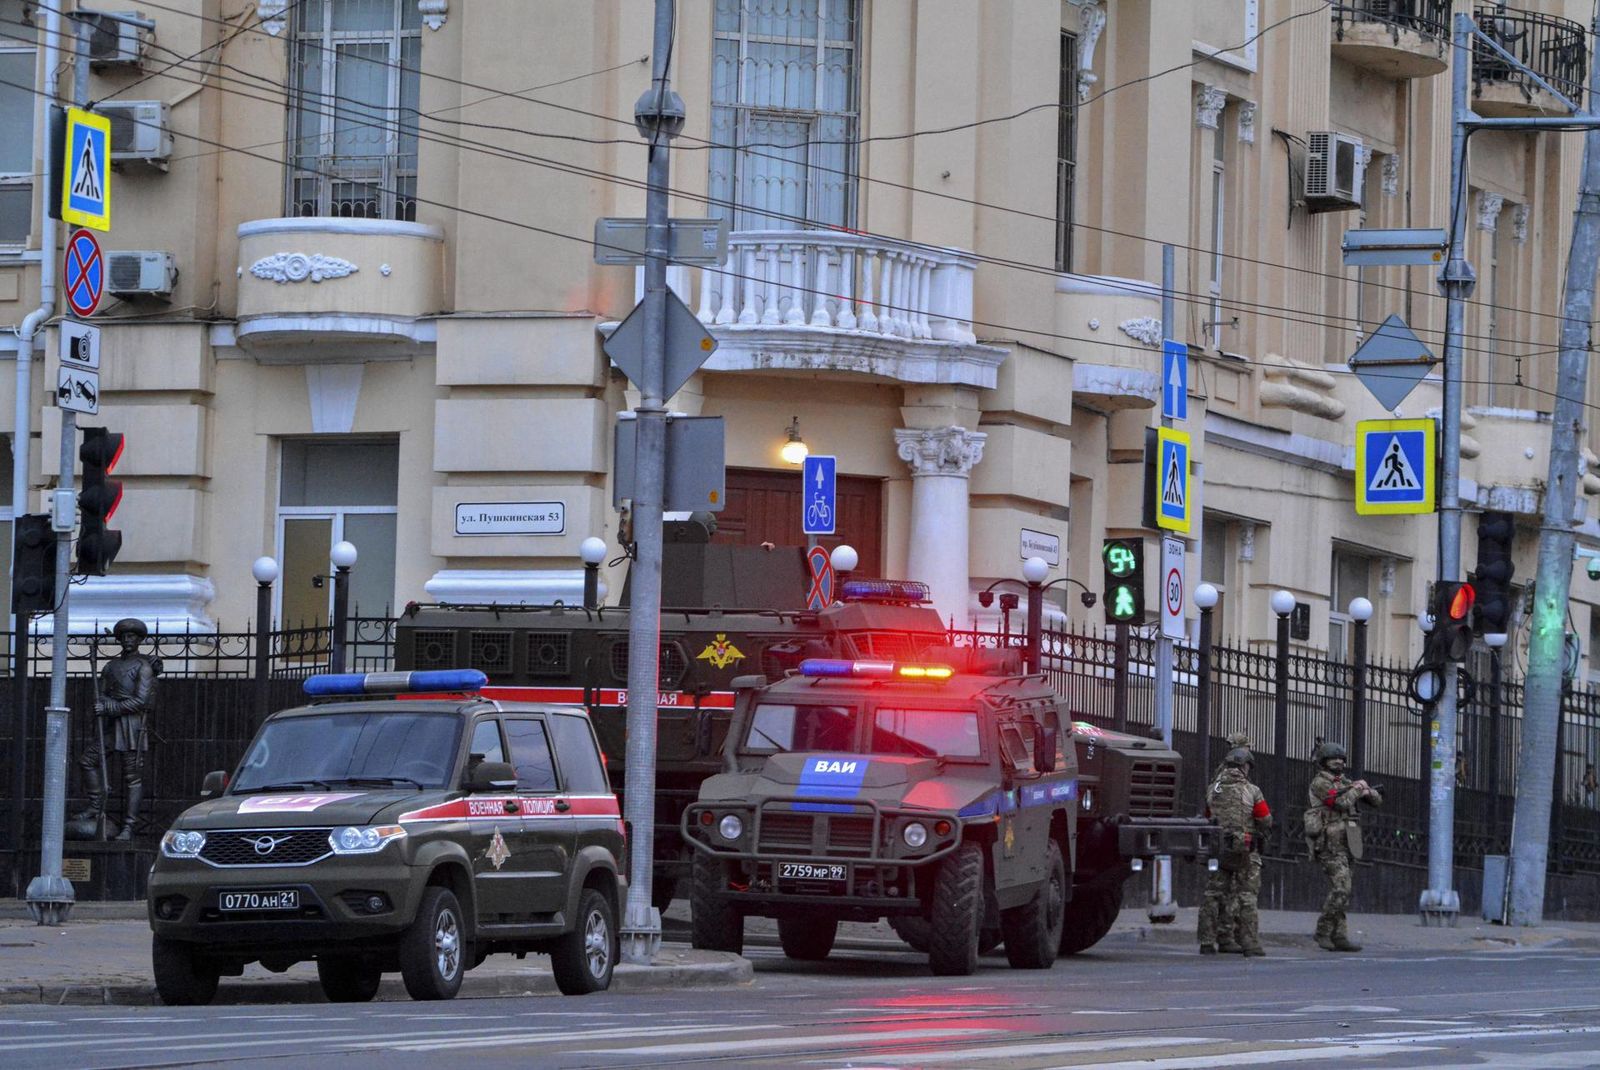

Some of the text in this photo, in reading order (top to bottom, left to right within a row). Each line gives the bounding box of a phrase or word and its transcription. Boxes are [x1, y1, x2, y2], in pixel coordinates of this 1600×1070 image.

[461, 512, 560, 525] ул. Пушкинская 53
[1168, 543, 1182, 556] ЗОНА
[1110, 548, 1136, 573] 54
[1169, 581, 1180, 603] 30
[814, 760, 857, 774] ВАИ
[468, 799, 556, 815] ВОЕННАЯ ПОЛИЦИЯ
[783, 864, 813, 877] 2759
[831, 866, 843, 876] 99
[225, 893, 259, 908] 0770
[281, 892, 295, 903] 21
